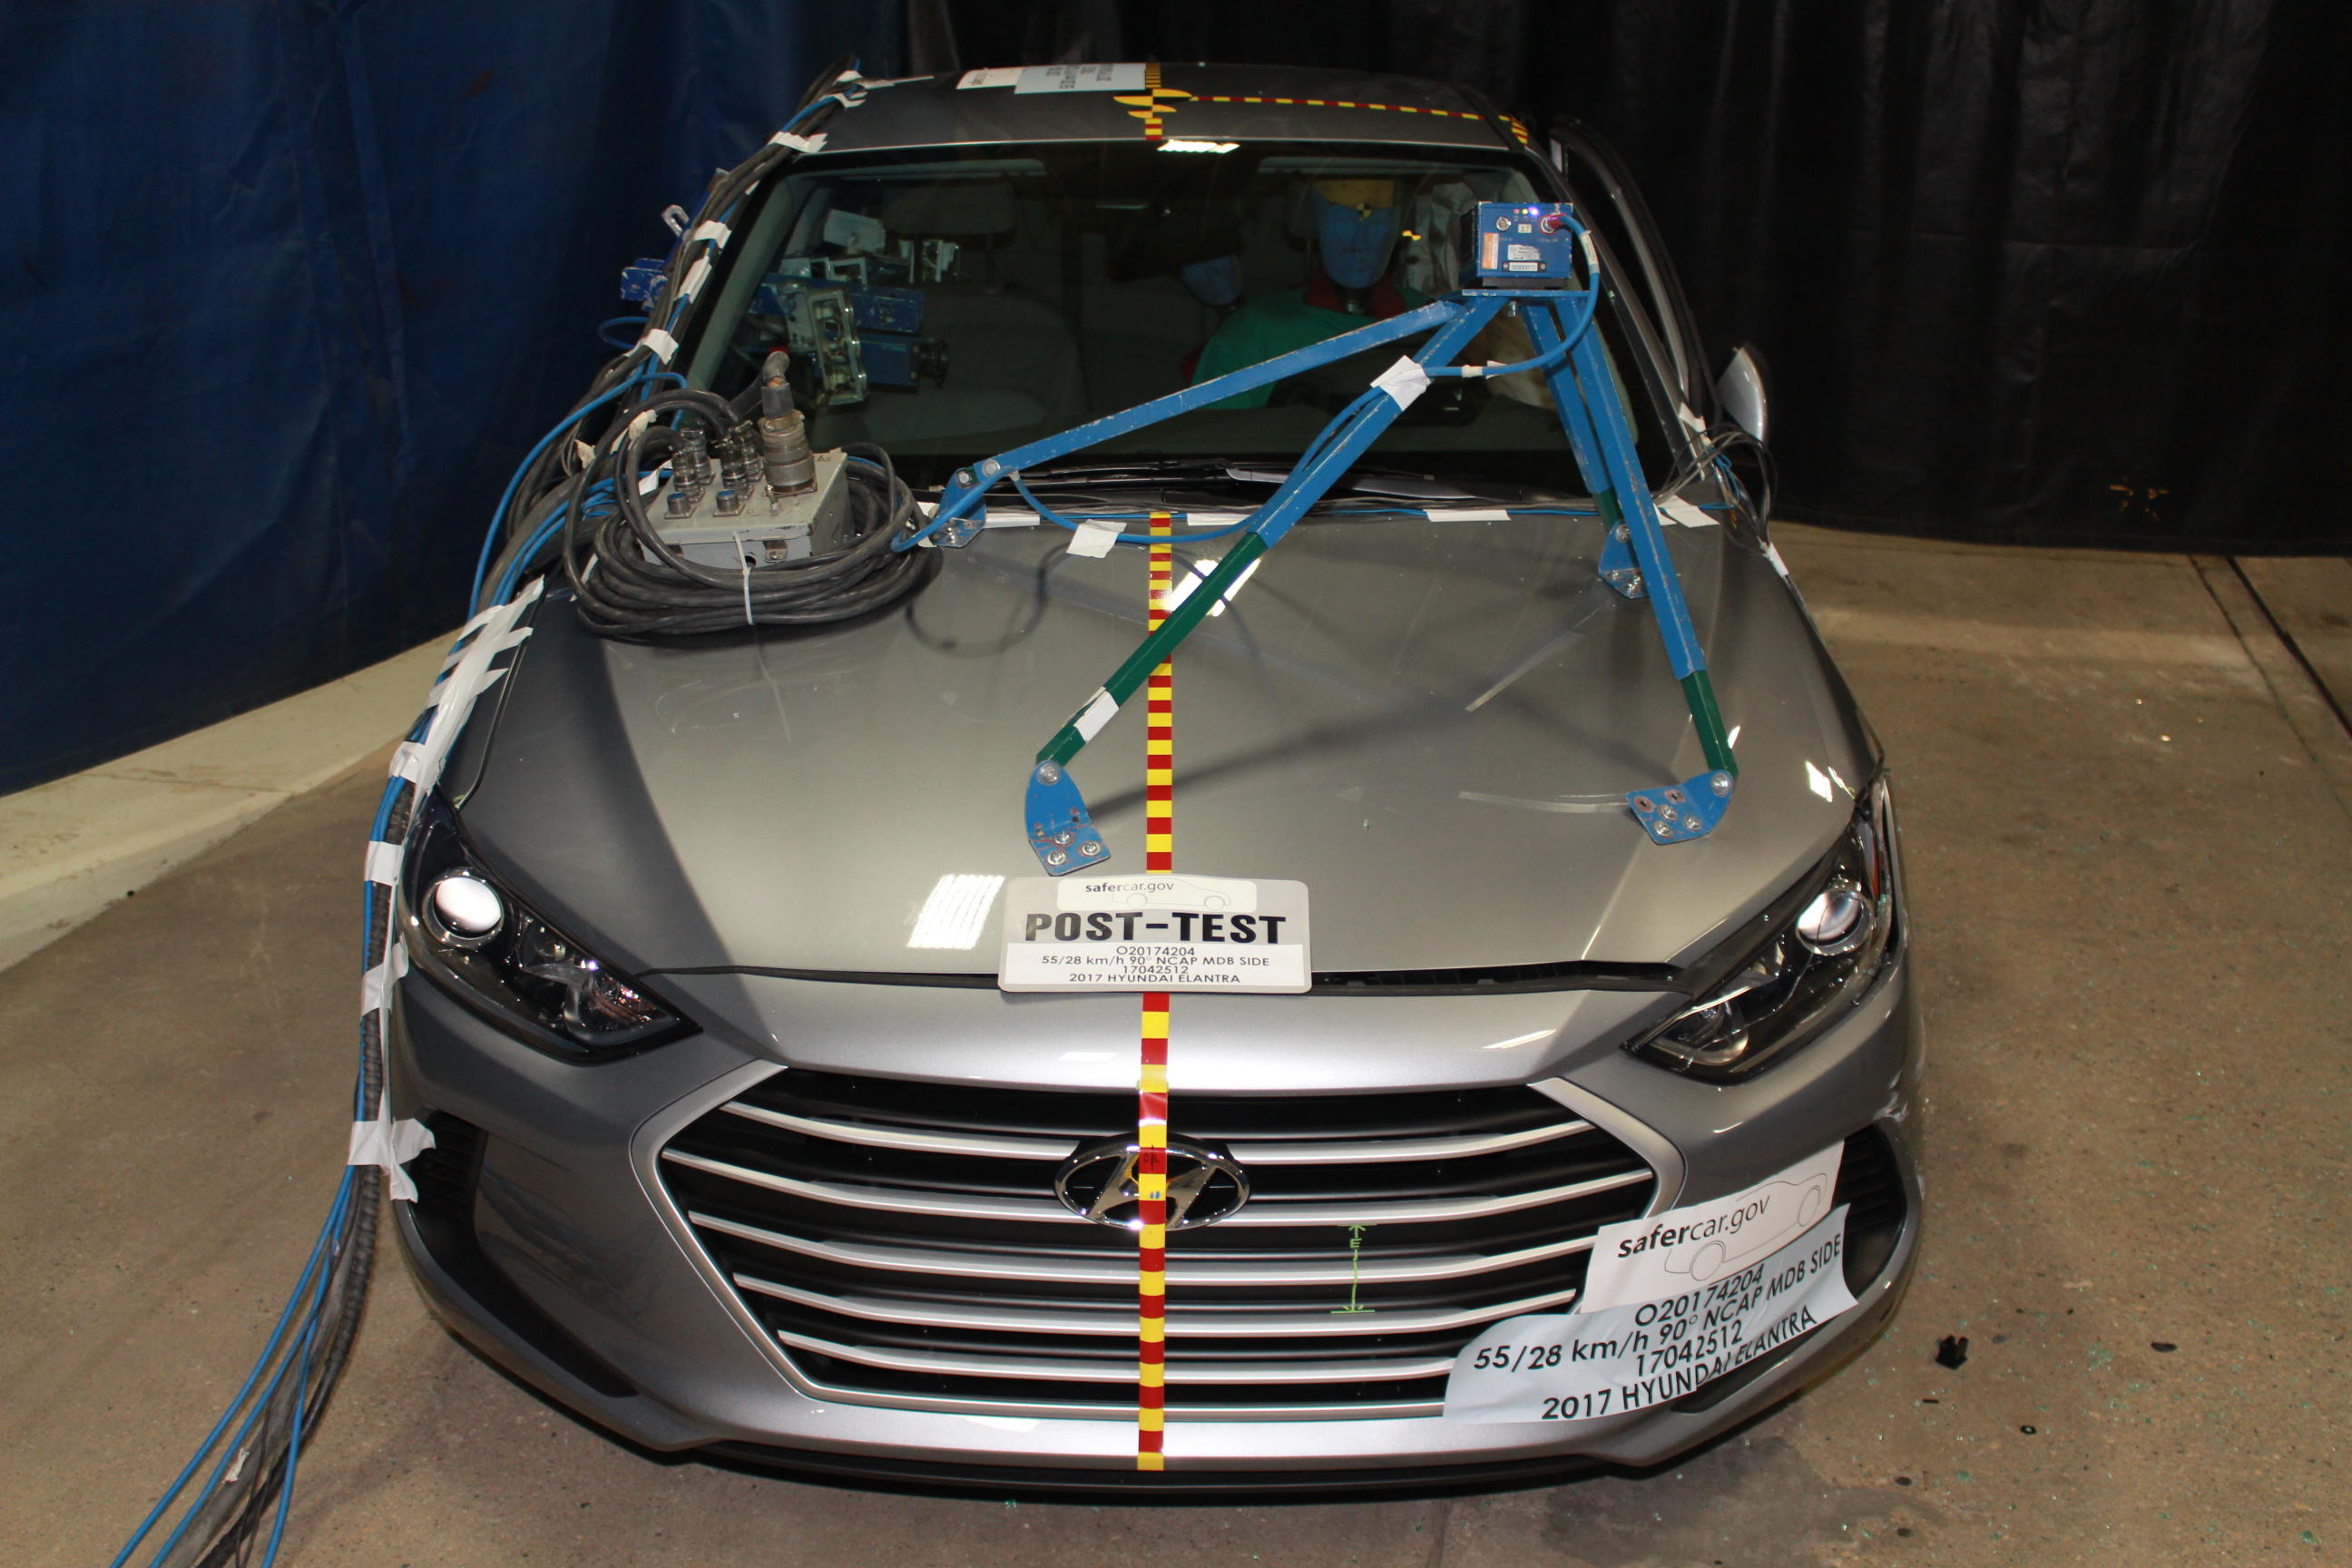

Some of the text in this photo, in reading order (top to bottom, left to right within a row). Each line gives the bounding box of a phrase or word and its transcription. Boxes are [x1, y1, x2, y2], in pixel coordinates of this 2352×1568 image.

[1085, 879, 1175, 894] safercar.gov
[1024, 911, 1287, 944] POST-TEST
[1042, 956, 1269, 966] 55/28 km/h 90° NCAP MDB SIDE
[1123, 965, 1189, 975] 17042512
[1069, 973, 1240, 983] 2017 HYUNDAI ELANTRA
[1617, 1194, 1771, 1259] safercar.gov
[1473, 1232, 1842, 1374] 55/28 km/h 90° NCAP MDB SIDE
[1542, 1305, 1818, 1420] 2017 HYUNDAI ELANTRA
[1636, 1318, 1743, 1377] 17042512
